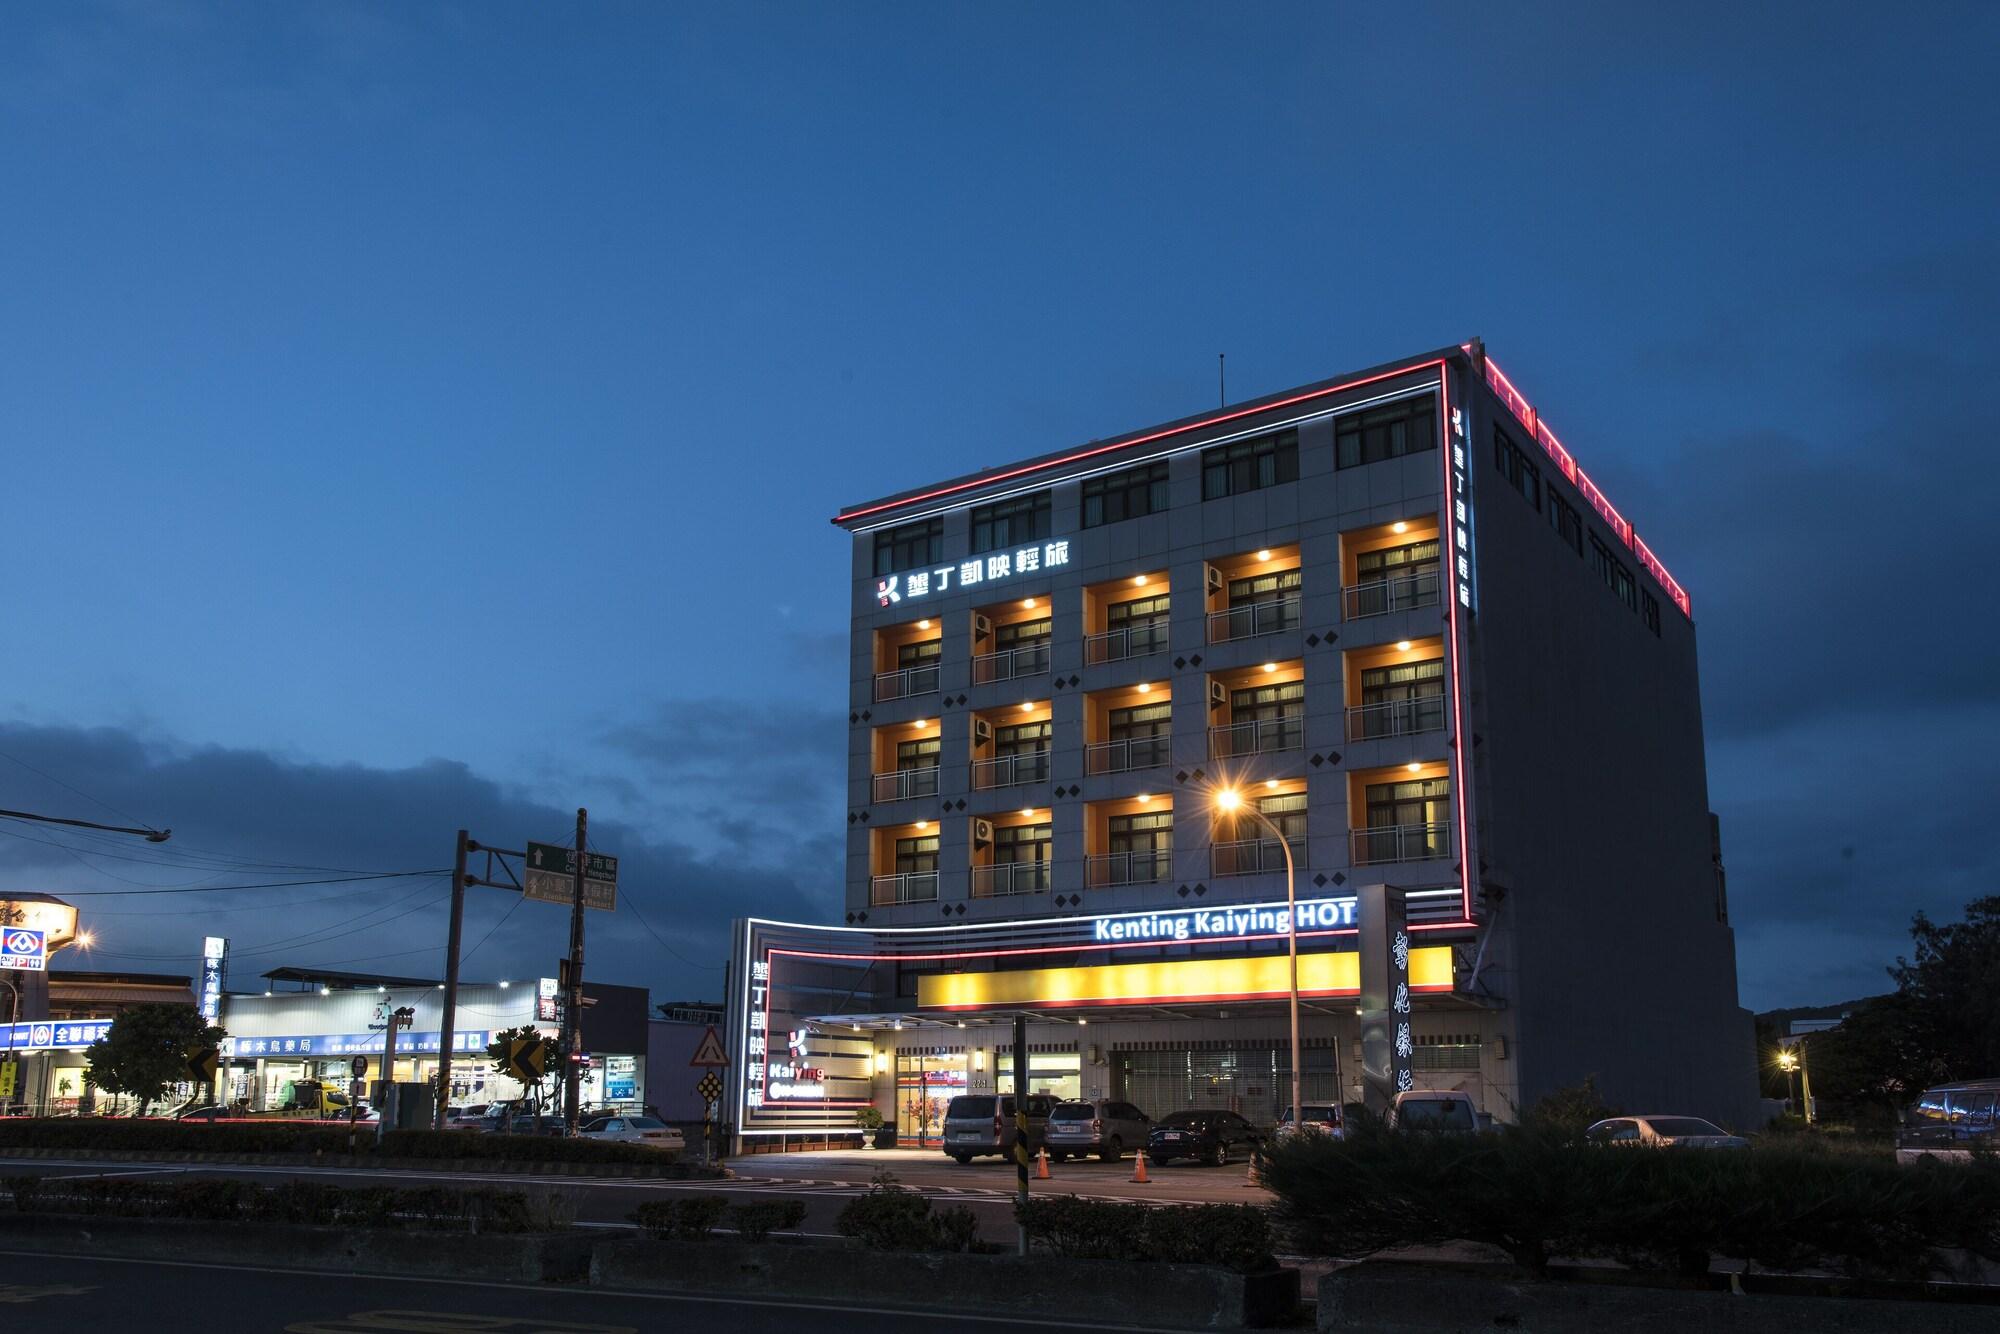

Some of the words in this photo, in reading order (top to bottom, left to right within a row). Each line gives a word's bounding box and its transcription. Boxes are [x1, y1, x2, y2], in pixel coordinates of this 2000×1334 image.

[907, 541, 1069, 598] 墾丁凱映輕旅
[1096, 915, 1189, 939] Kenting
[1194, 908, 1290, 934] Kaiying
[240, 1039, 311, 1053] 啄木鳥藥局
[747, 962, 768, 1106] 墾丁凱映輕旅
[769, 1061, 825, 1082] Kaiying
